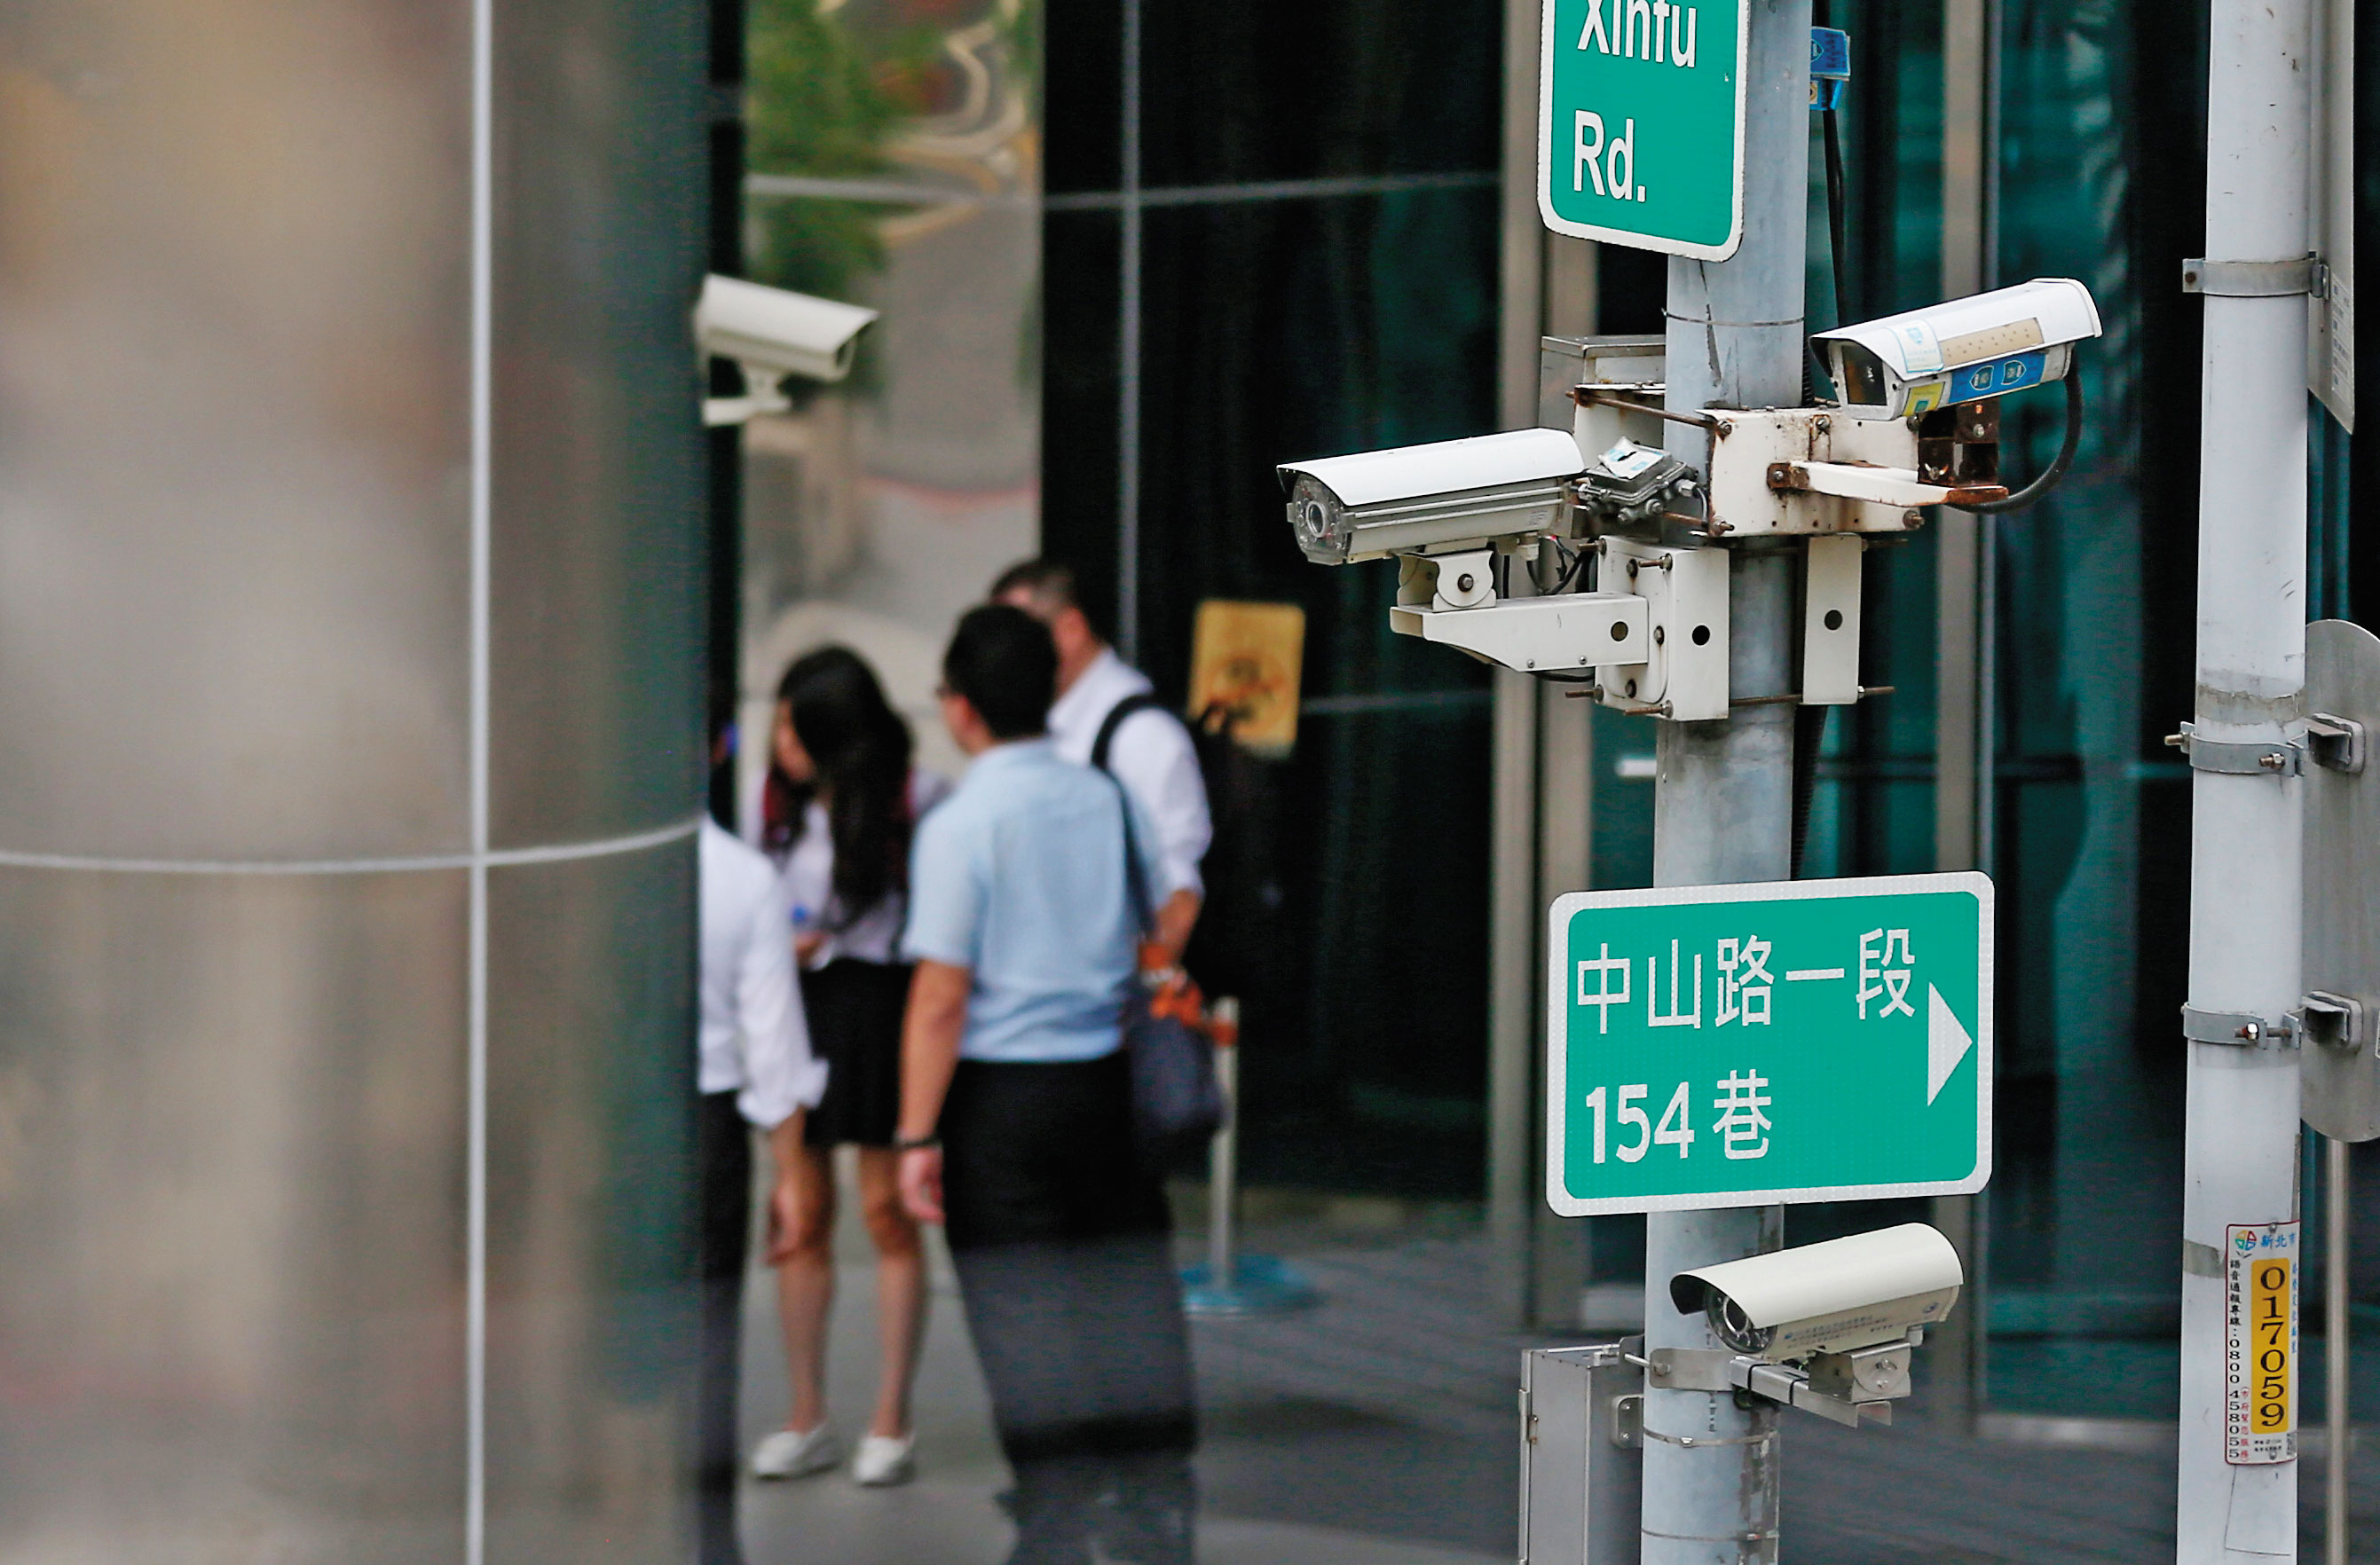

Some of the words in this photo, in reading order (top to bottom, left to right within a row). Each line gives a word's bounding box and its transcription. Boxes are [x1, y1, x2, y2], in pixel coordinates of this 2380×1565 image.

[1577, 0, 1697, 68] Xinfu
[1573, 109, 1646, 202] Rd.
[1577, 927, 1916, 1034] 中山路一段
[2260, 1267, 2286, 1427] 017059
